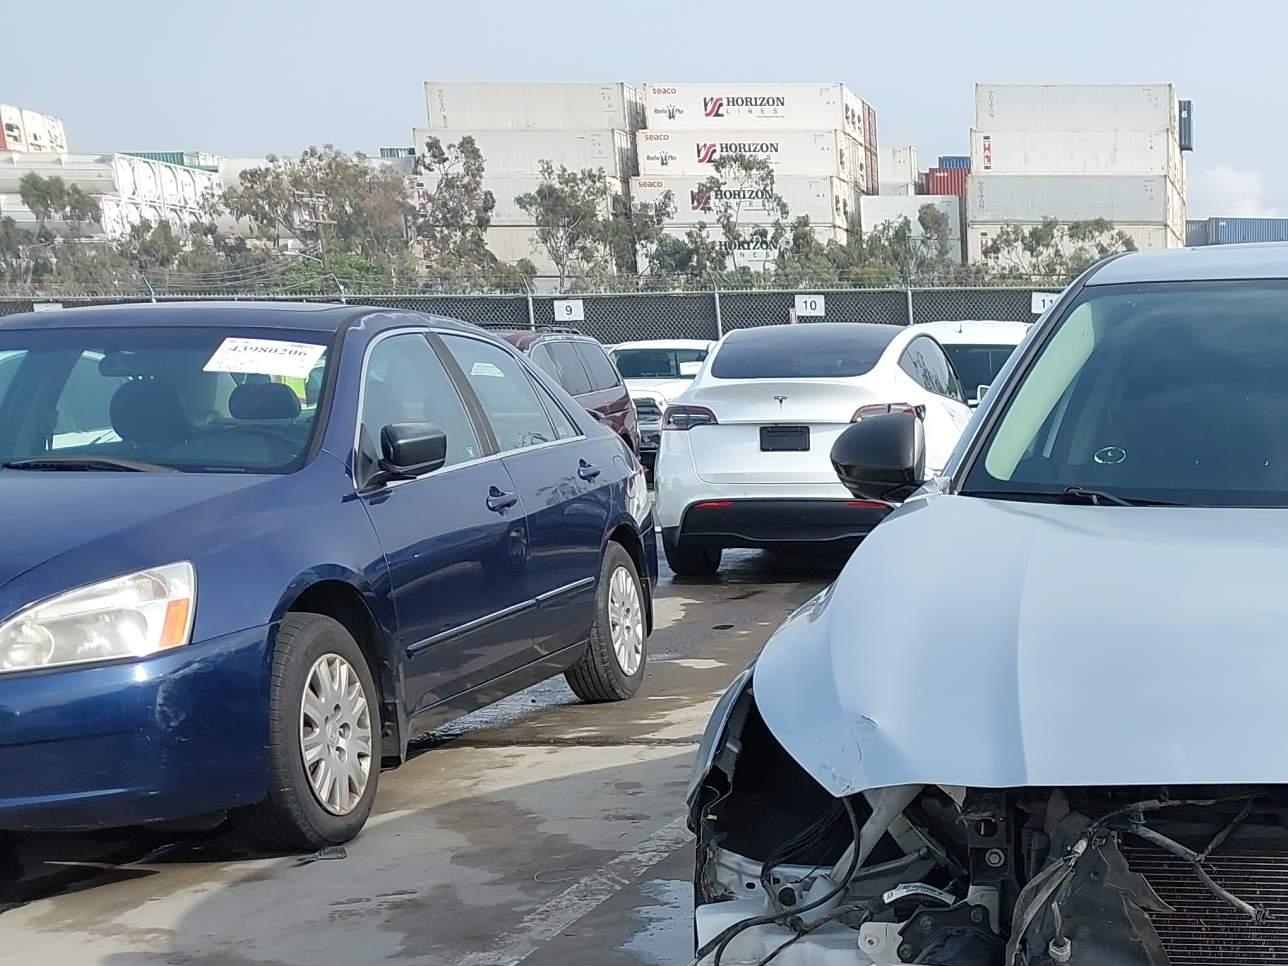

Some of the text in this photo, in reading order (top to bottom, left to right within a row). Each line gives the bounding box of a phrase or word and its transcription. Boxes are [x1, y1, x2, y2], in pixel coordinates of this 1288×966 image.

[652, 87, 677, 95] seaco
[726, 96, 785, 107] HORIZON
[726, 107, 778, 115] LINES
[644, 133, 669, 142] seaco
[719, 142, 779, 153] HORIZON
[637, 180, 663, 188] seaco
[714, 189, 774, 200] HORIZON
[565, 304, 573, 316] 9
[802, 299, 817, 311] 10
